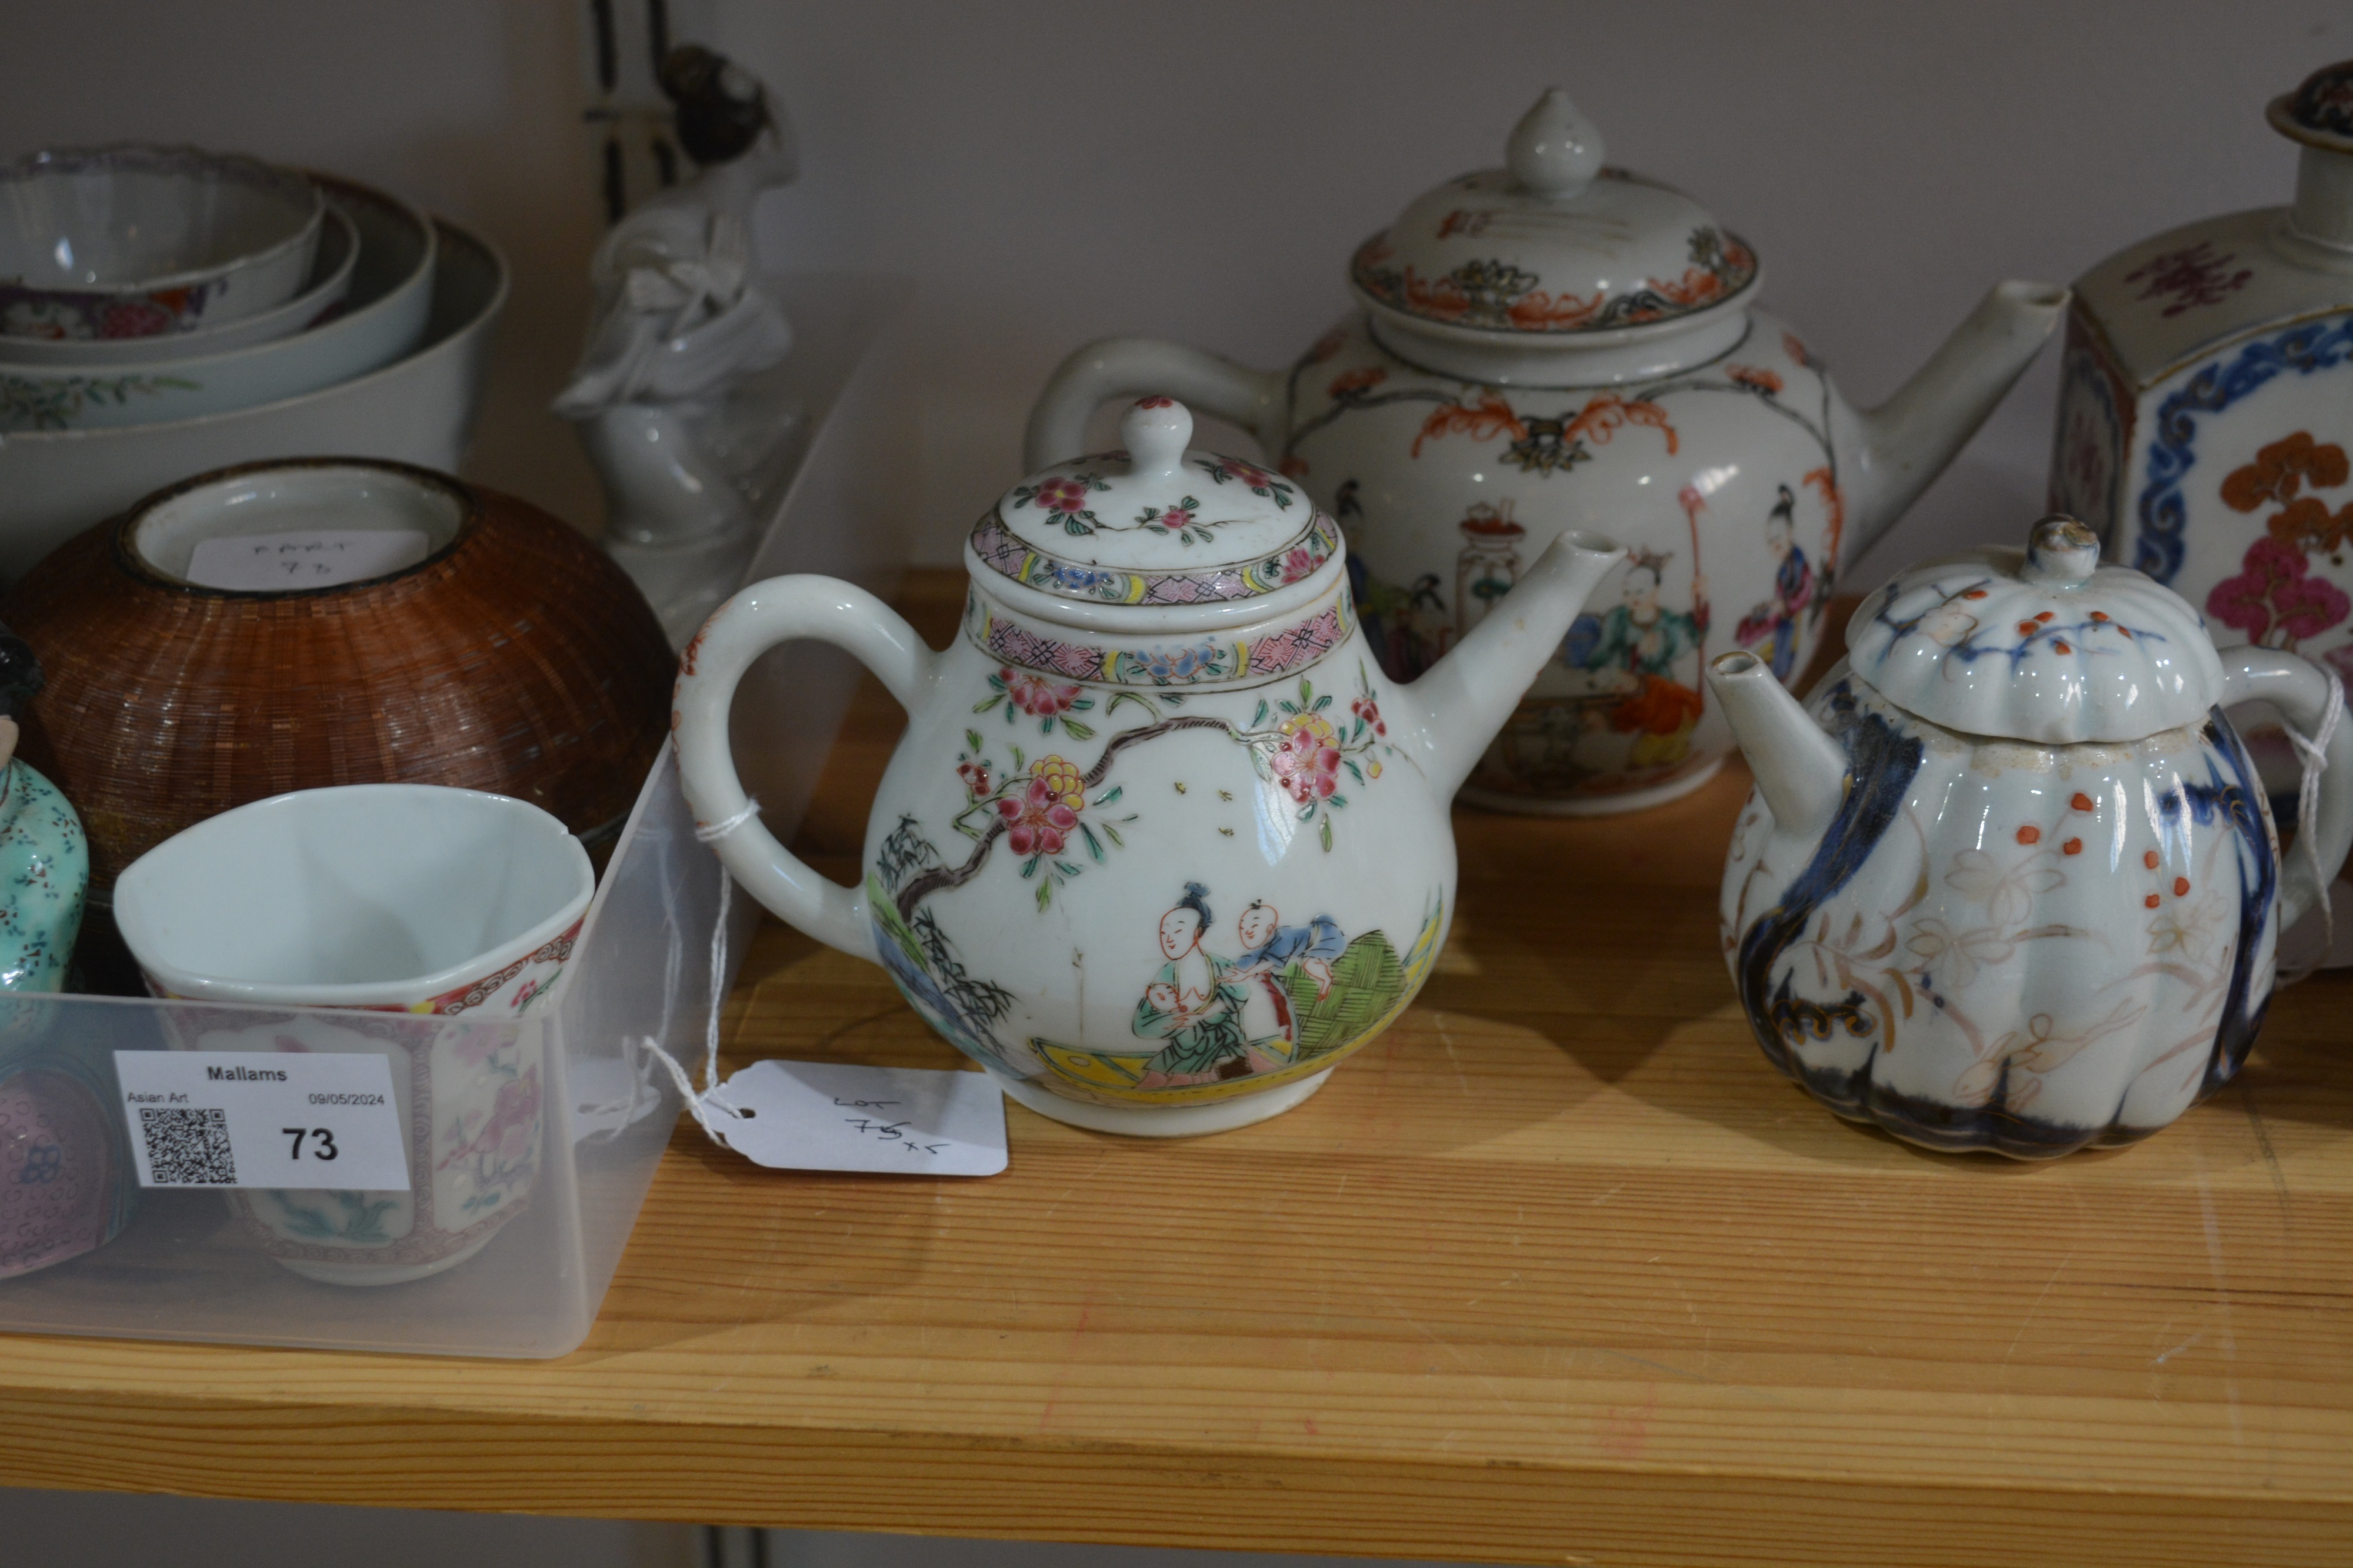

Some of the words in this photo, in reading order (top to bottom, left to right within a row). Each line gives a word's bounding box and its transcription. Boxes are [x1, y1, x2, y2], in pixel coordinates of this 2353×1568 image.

[207, 1066, 288, 1082] Mallams
[126, 1092, 165, 1103] Asian
[169, 1092, 189, 1103] Art
[308, 1093, 385, 1106] 09/05/2024
[281, 1127, 339, 1161] 73
